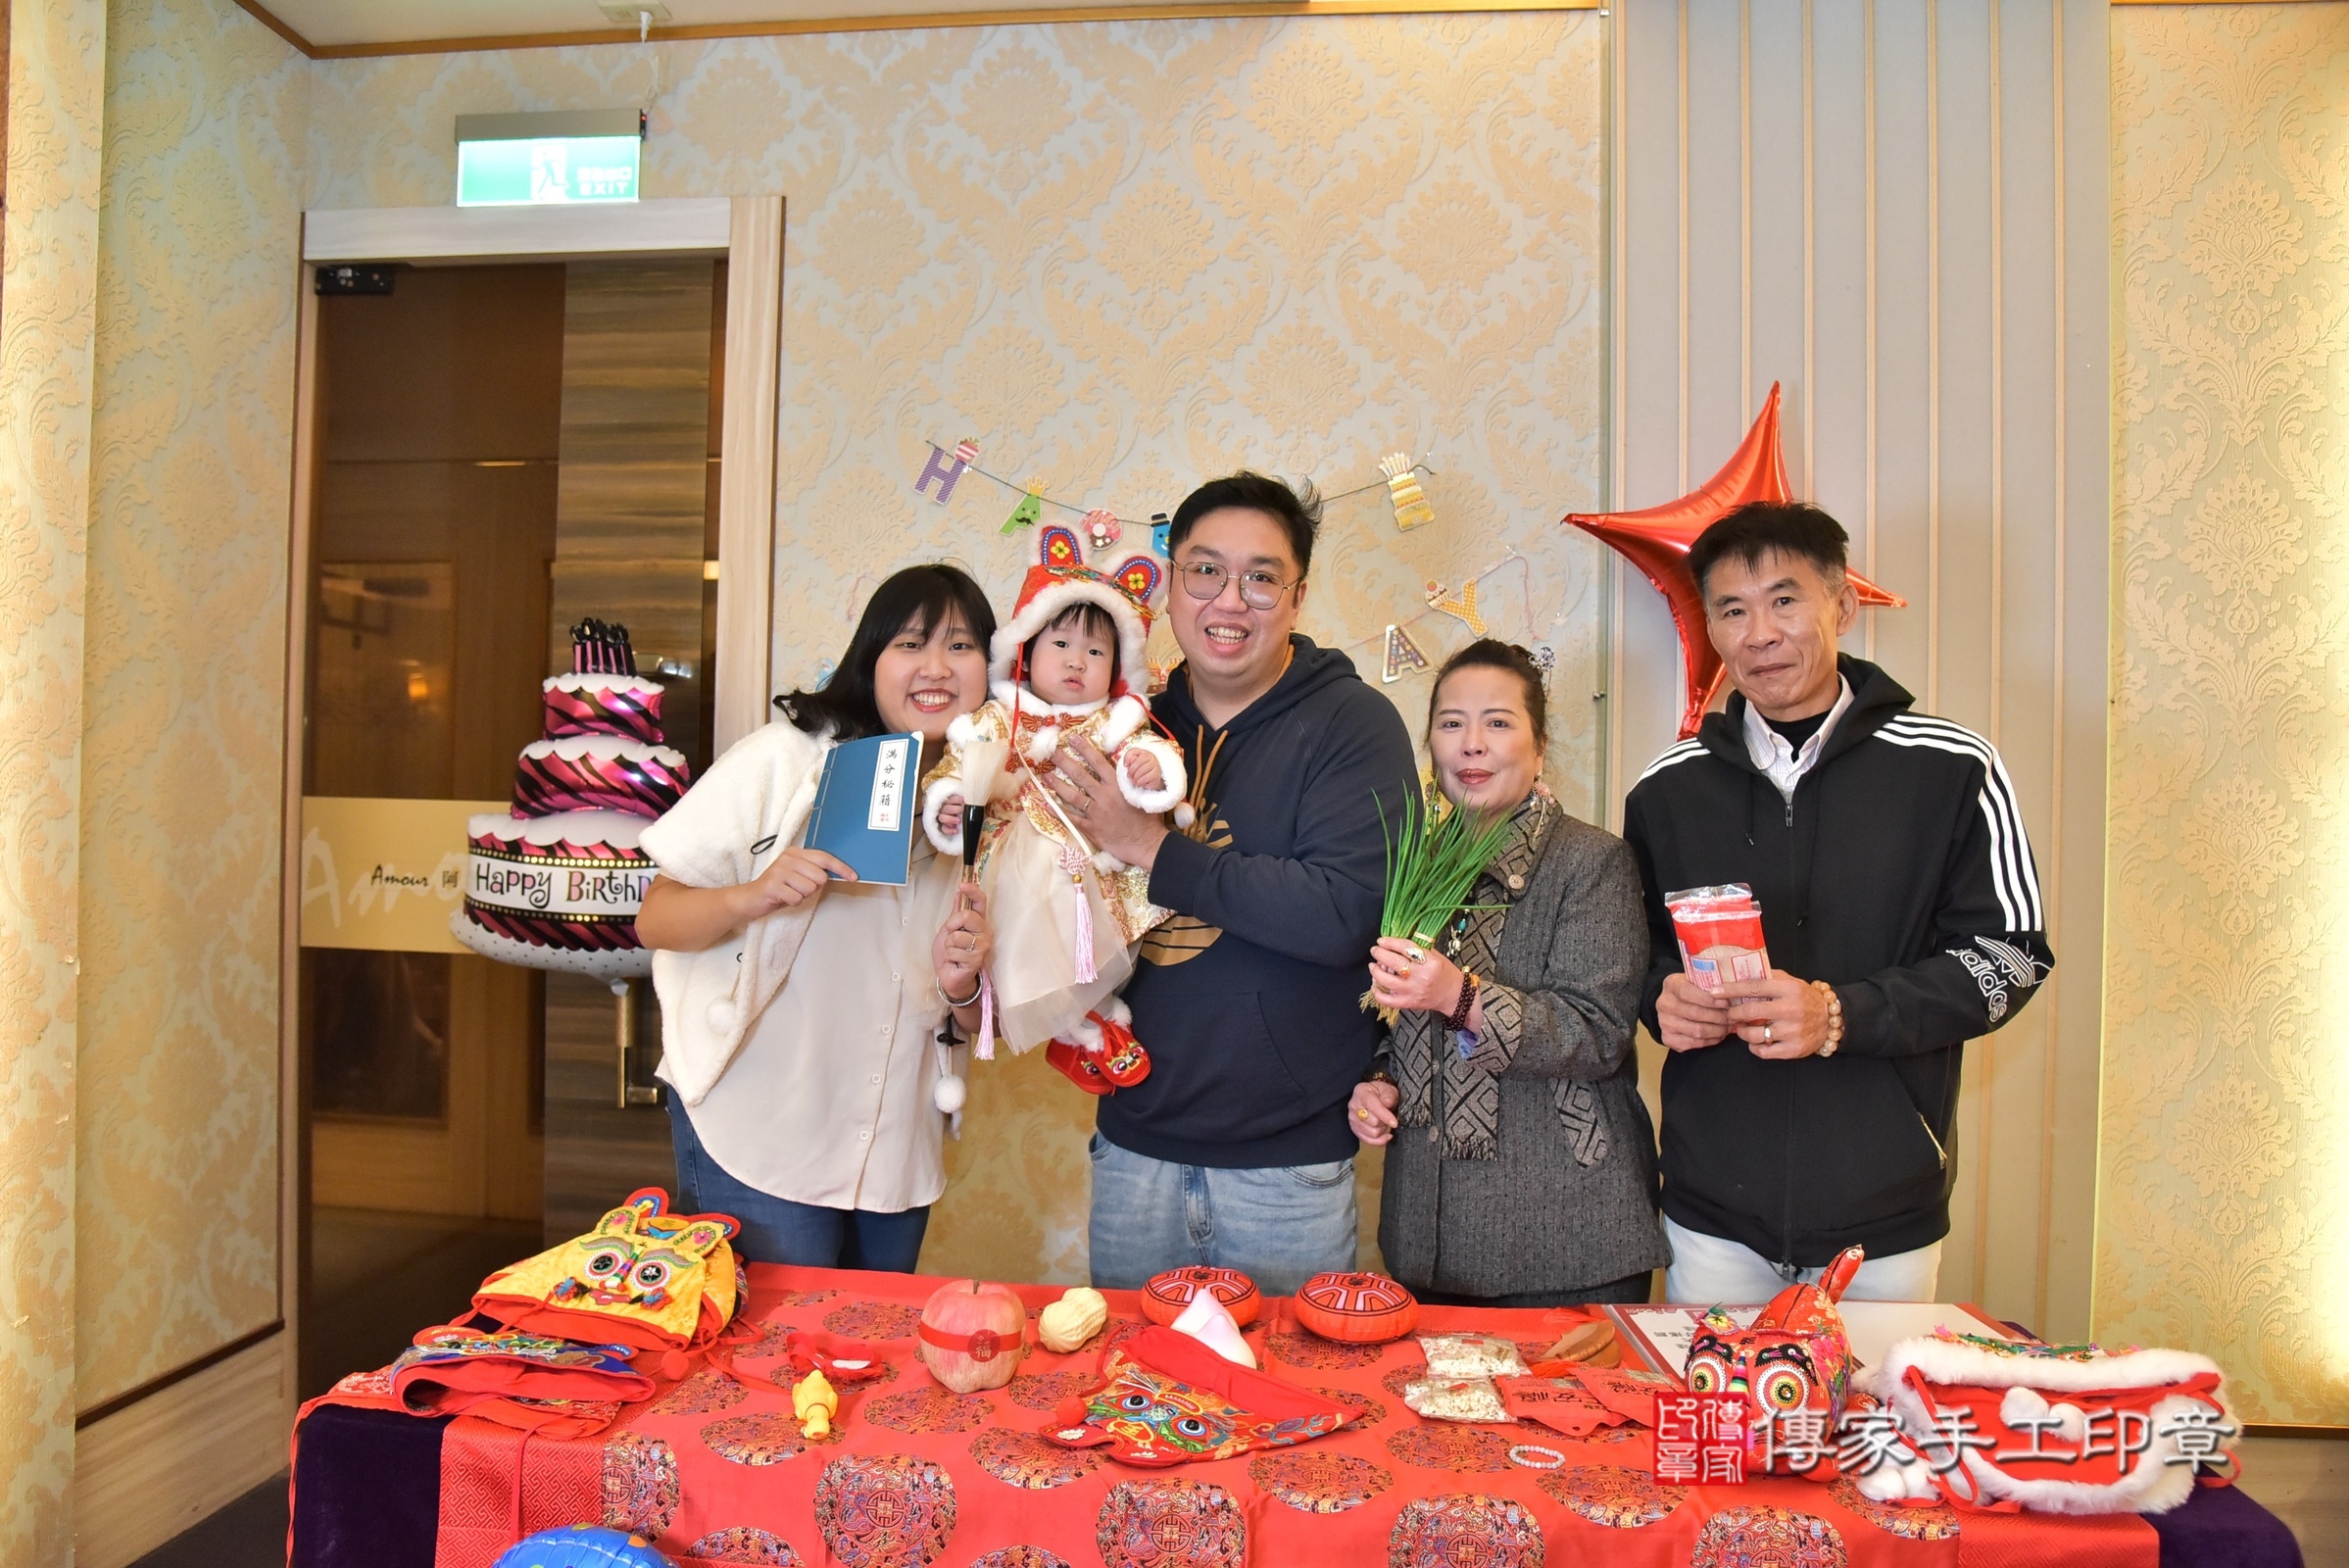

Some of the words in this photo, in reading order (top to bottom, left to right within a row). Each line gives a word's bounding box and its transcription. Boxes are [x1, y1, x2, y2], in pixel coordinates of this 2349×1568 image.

[579, 182, 628, 196] EXIT
[370, 864, 430, 887] Amour
[476, 862, 552, 908] Happy
[1945, 948, 2008, 1023] didas
